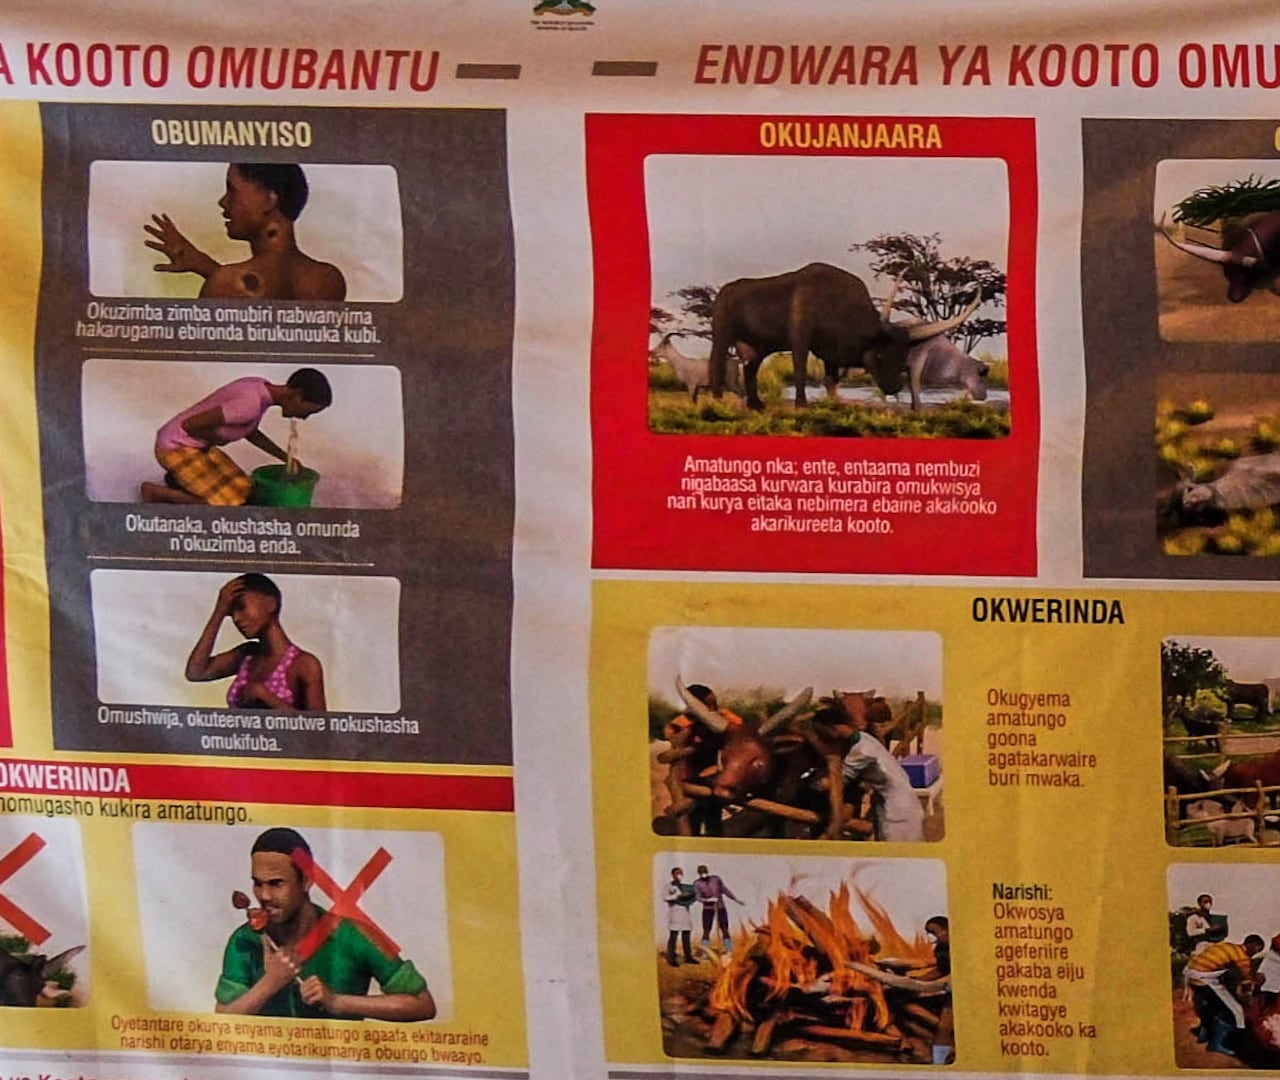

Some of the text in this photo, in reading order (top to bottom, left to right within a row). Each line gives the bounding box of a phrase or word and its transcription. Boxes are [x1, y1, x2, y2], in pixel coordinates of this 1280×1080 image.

[26, 42, 441, 92] KOOTO OMUBANTU
[693, 44, 919, 86] ENDWARA
[938, 44, 992, 87] YA
[1008, 44, 1160, 87] KOOTO
[151, 119, 313, 147] OBUMANYISO
[759, 121, 942, 149] OKUJANJAARA
[86, 304, 274, 323] Okuzimba zimba omubiri
[683, 455, 980, 479] Amatungo entaama nembuzi
[751, 515, 894, 533] akarikureeta kooto.
[170, 535, 301, 554] n'okuzimba enda.
[972, 597, 1126, 625] OKWERINDA
[986, 688, 1071, 712] Okugyema
[986, 710, 1067, 730] amatungo
[987, 733, 1037, 750] goona
[988, 769, 1085, 788] buri mwaka.
[99, 800, 253, 826] kukira amatungo.
[992, 883, 1054, 901] Narishi:
[993, 903, 1065, 925] Okwosya
[998, 983, 1057, 999] kwenda
[999, 1022, 1097, 1038] akakooko ka
[1001, 1041, 1050, 1057] kooto.
